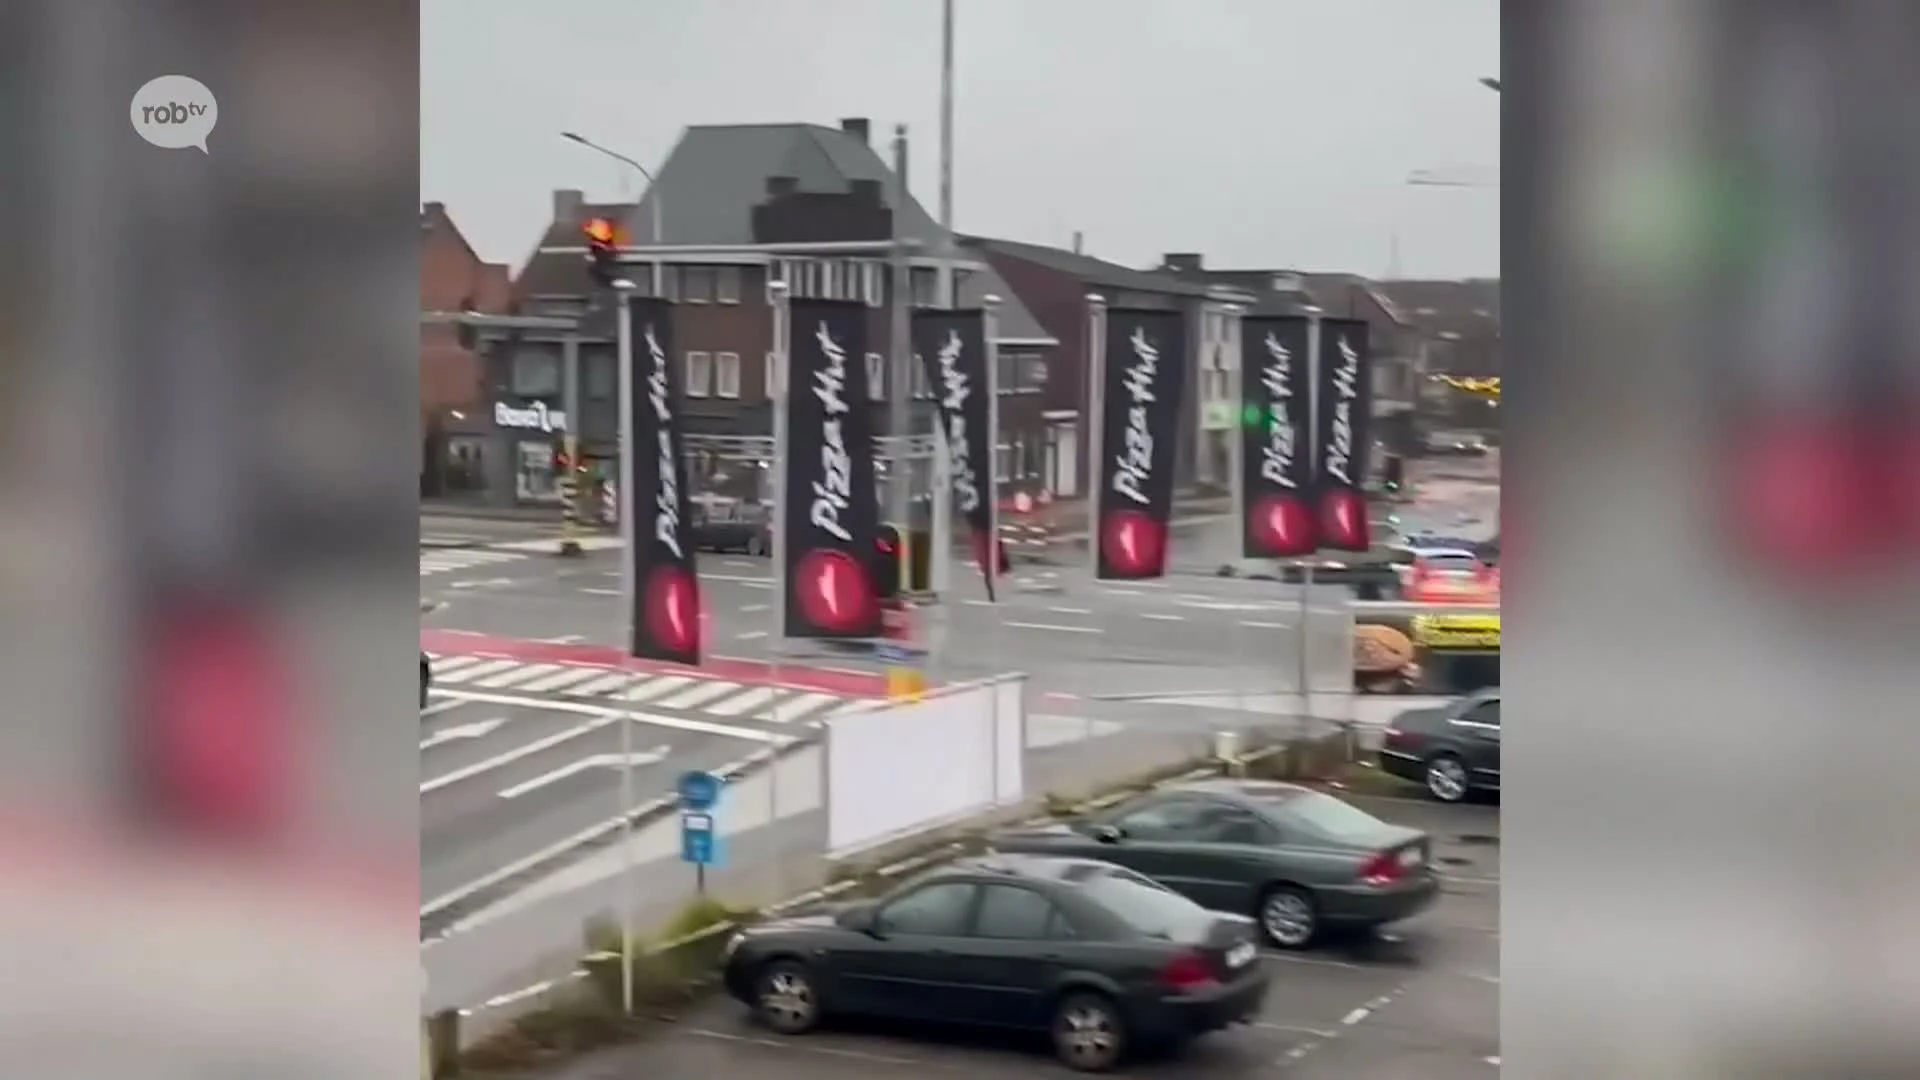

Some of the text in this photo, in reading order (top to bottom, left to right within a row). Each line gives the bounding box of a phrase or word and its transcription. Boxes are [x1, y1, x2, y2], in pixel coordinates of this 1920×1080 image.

[811, 320, 853, 541] Pizza Hut
[1112, 326, 1160, 504] Pizza Hut
[1261, 329, 1298, 488] Pizza Hut
